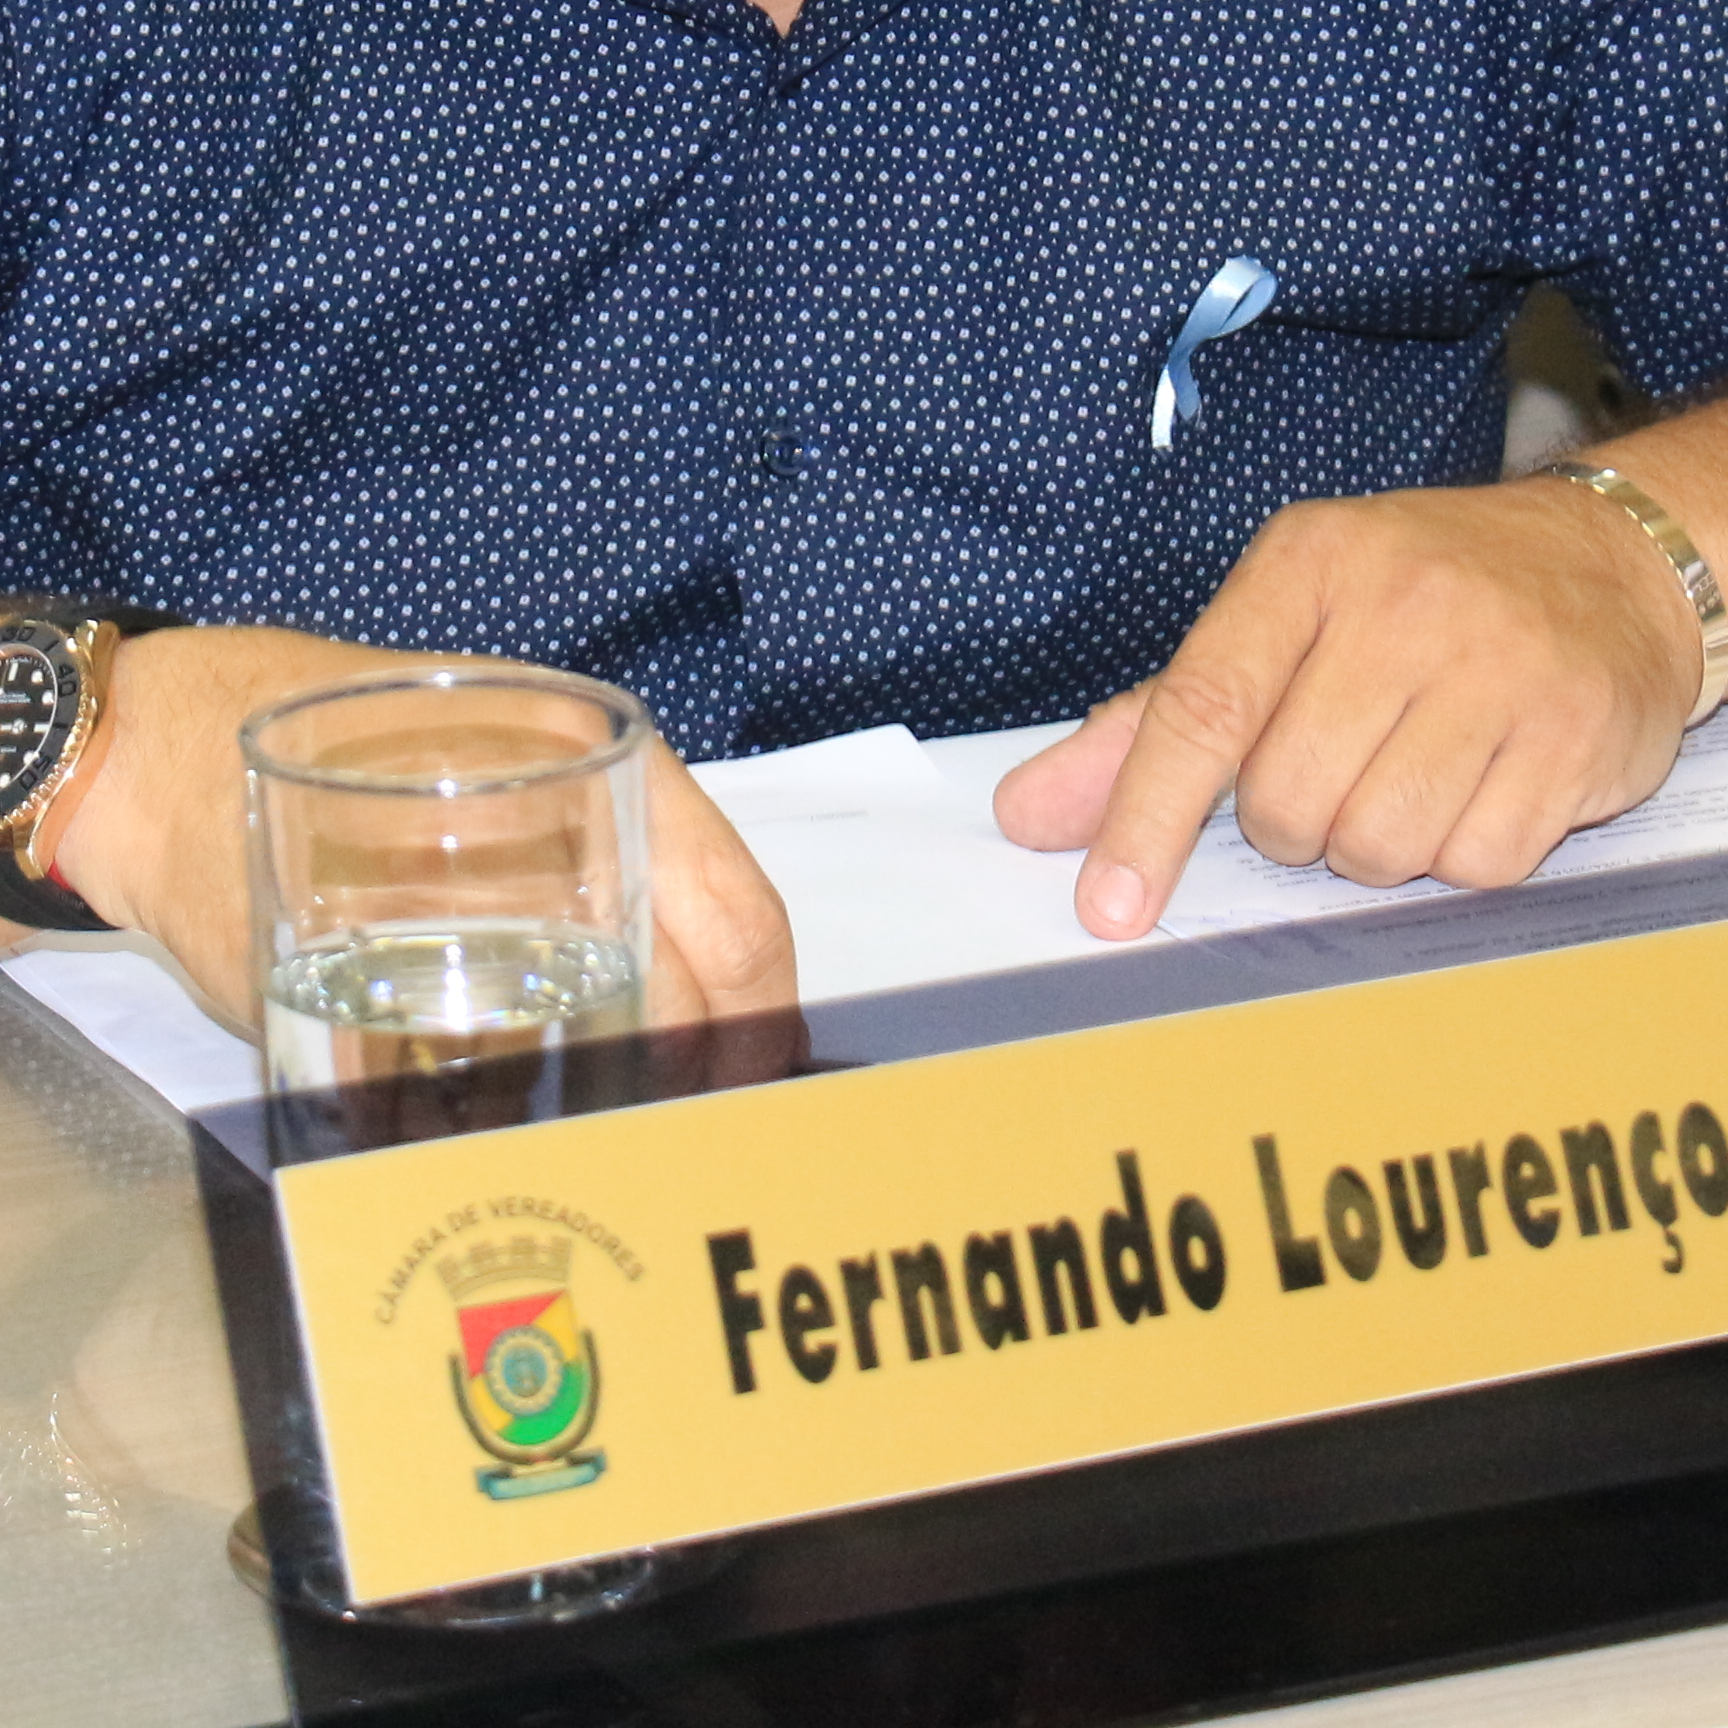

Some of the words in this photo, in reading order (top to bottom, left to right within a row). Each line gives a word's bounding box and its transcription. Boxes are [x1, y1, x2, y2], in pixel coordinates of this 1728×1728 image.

[447, 1203, 479, 1232] DE
[487, 1195, 645, 1282] VEREADORES
[705, 1148, 1227, 1395] Fernando
